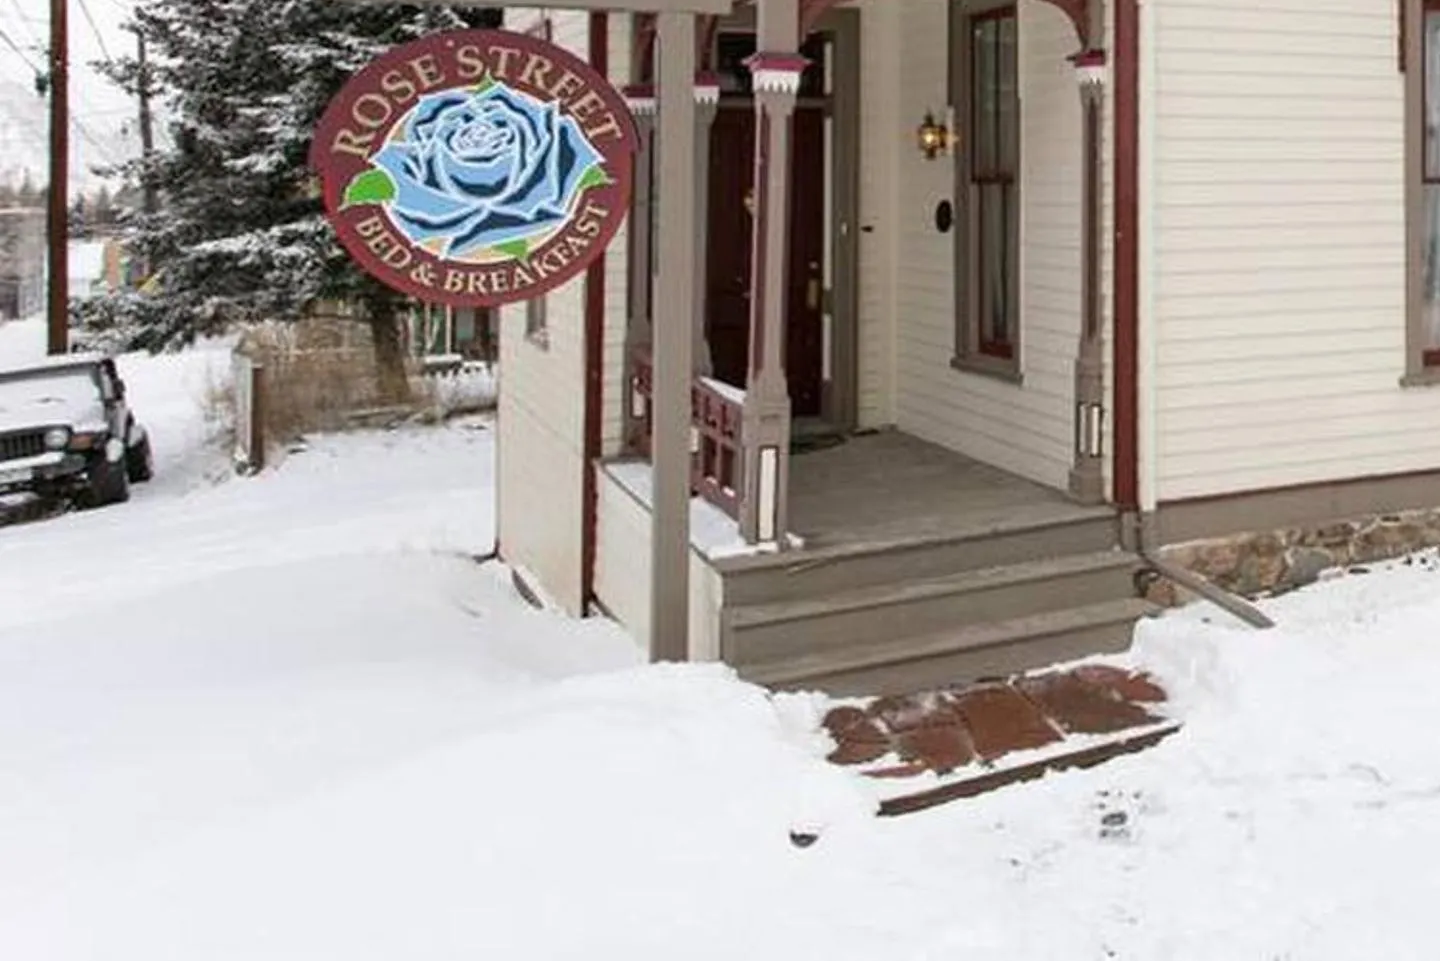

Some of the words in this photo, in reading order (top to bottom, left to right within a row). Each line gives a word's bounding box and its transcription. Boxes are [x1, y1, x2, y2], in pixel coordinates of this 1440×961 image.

[331, 54, 446, 160] ROSE
[456, 45, 622, 141] STREET
[355, 215, 412, 269] BED
[410, 263, 438, 287] &
[444, 203, 609, 293] BREAKFAST
